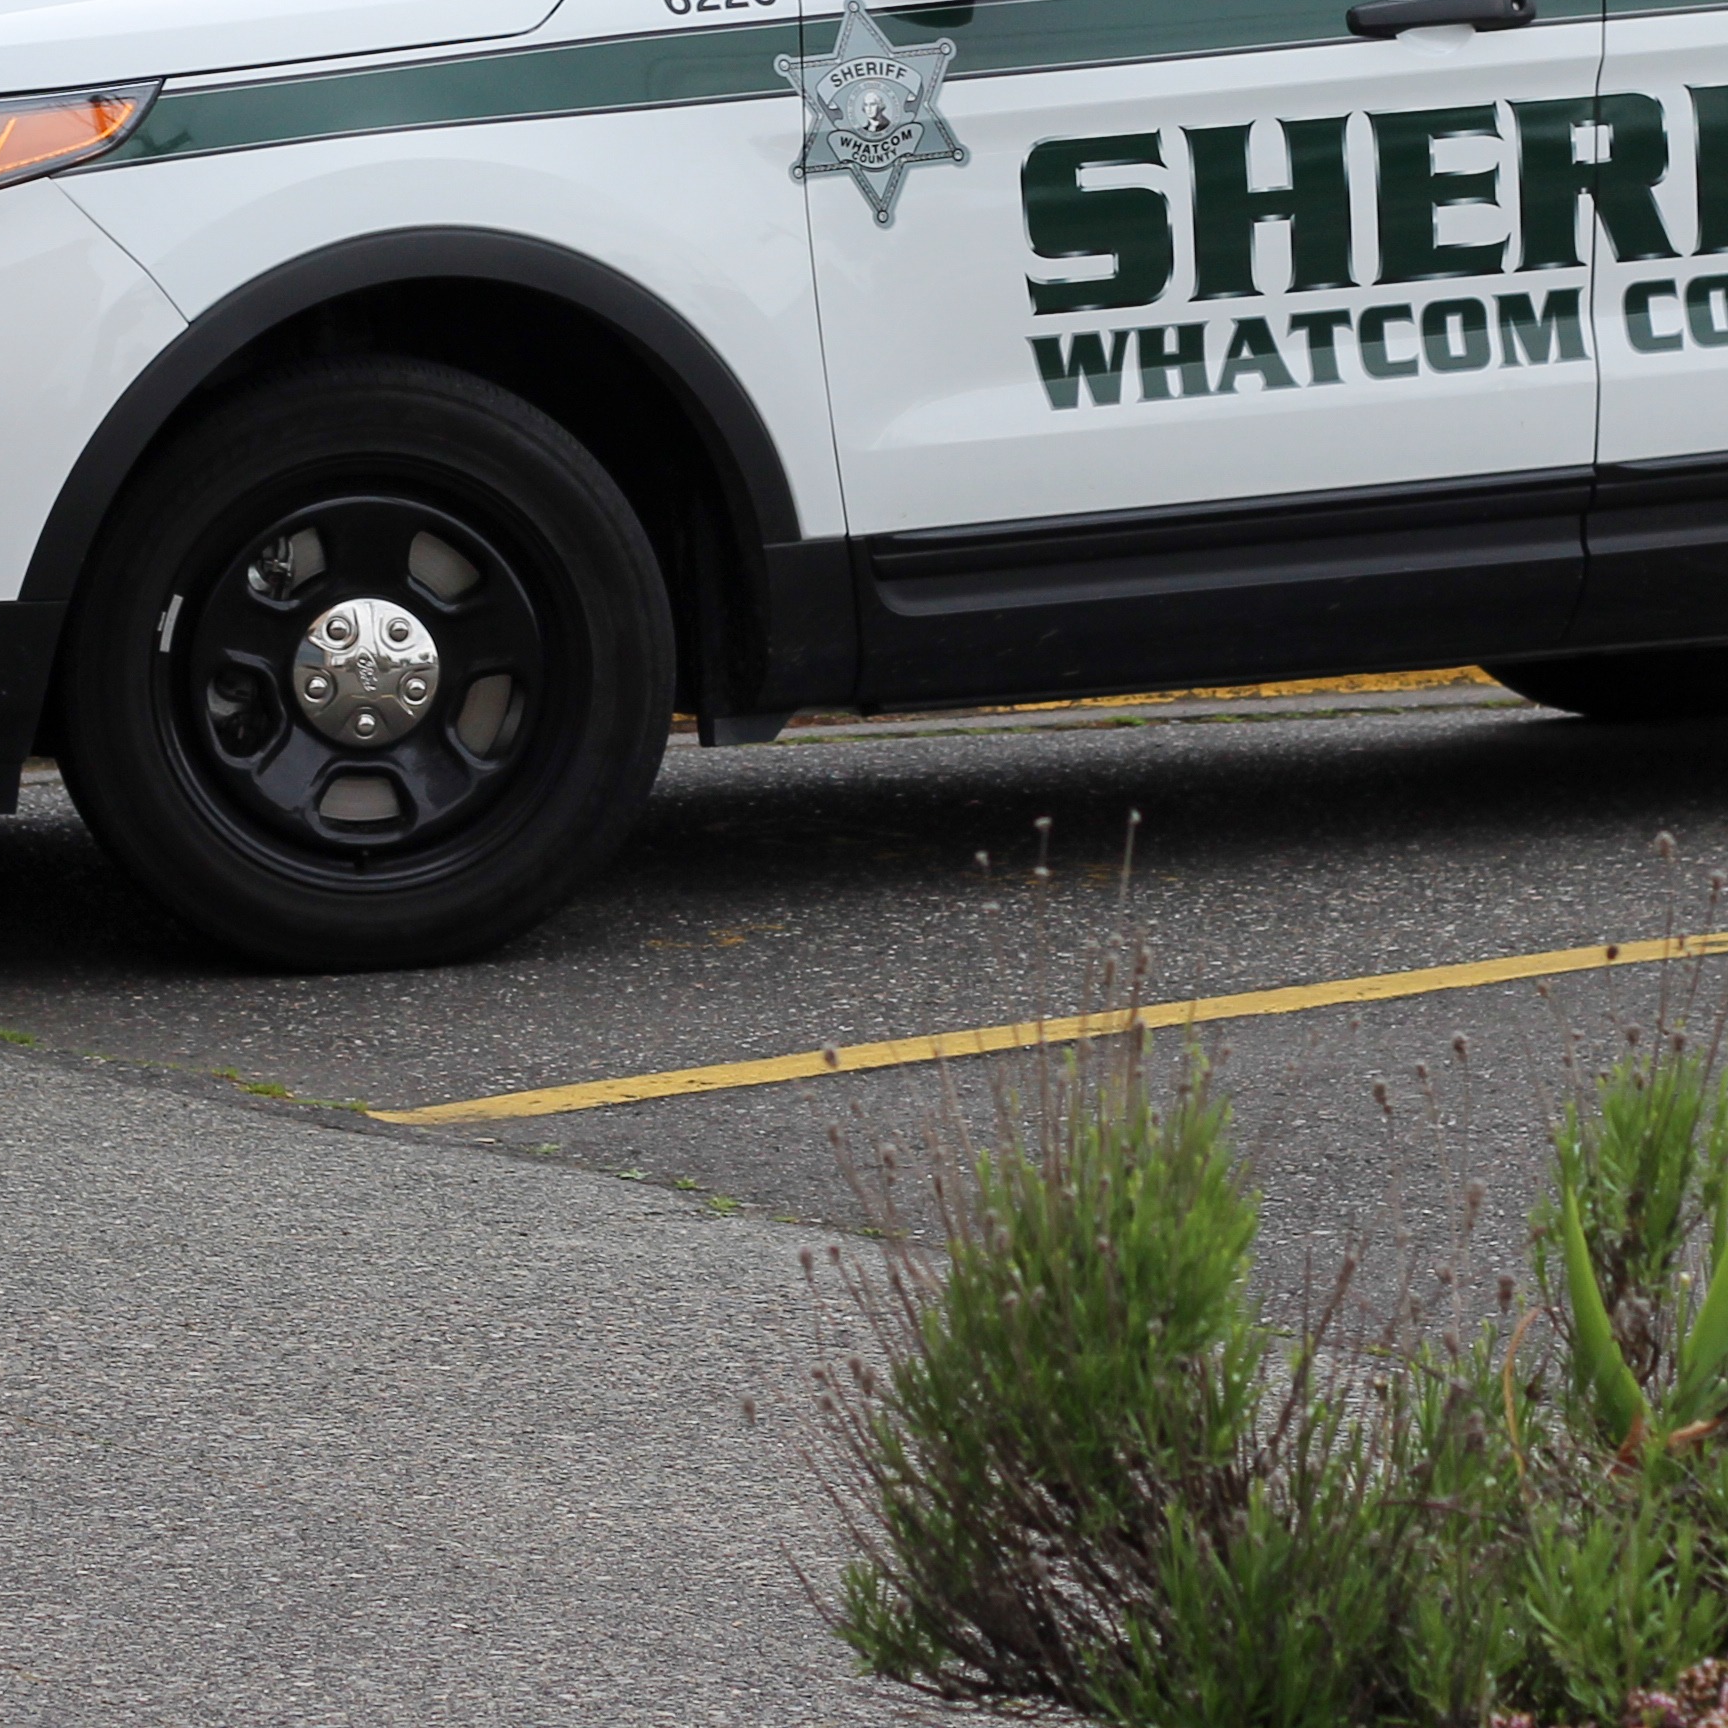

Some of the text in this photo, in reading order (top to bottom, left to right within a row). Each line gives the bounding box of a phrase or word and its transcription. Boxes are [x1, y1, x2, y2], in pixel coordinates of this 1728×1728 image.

[830, 62, 908, 88] SHERIFF
[839, 129, 913, 154] WHATCOM
[852, 147, 897, 164] COUNTY
[1023, 286, 1592, 411] WHATCOM
